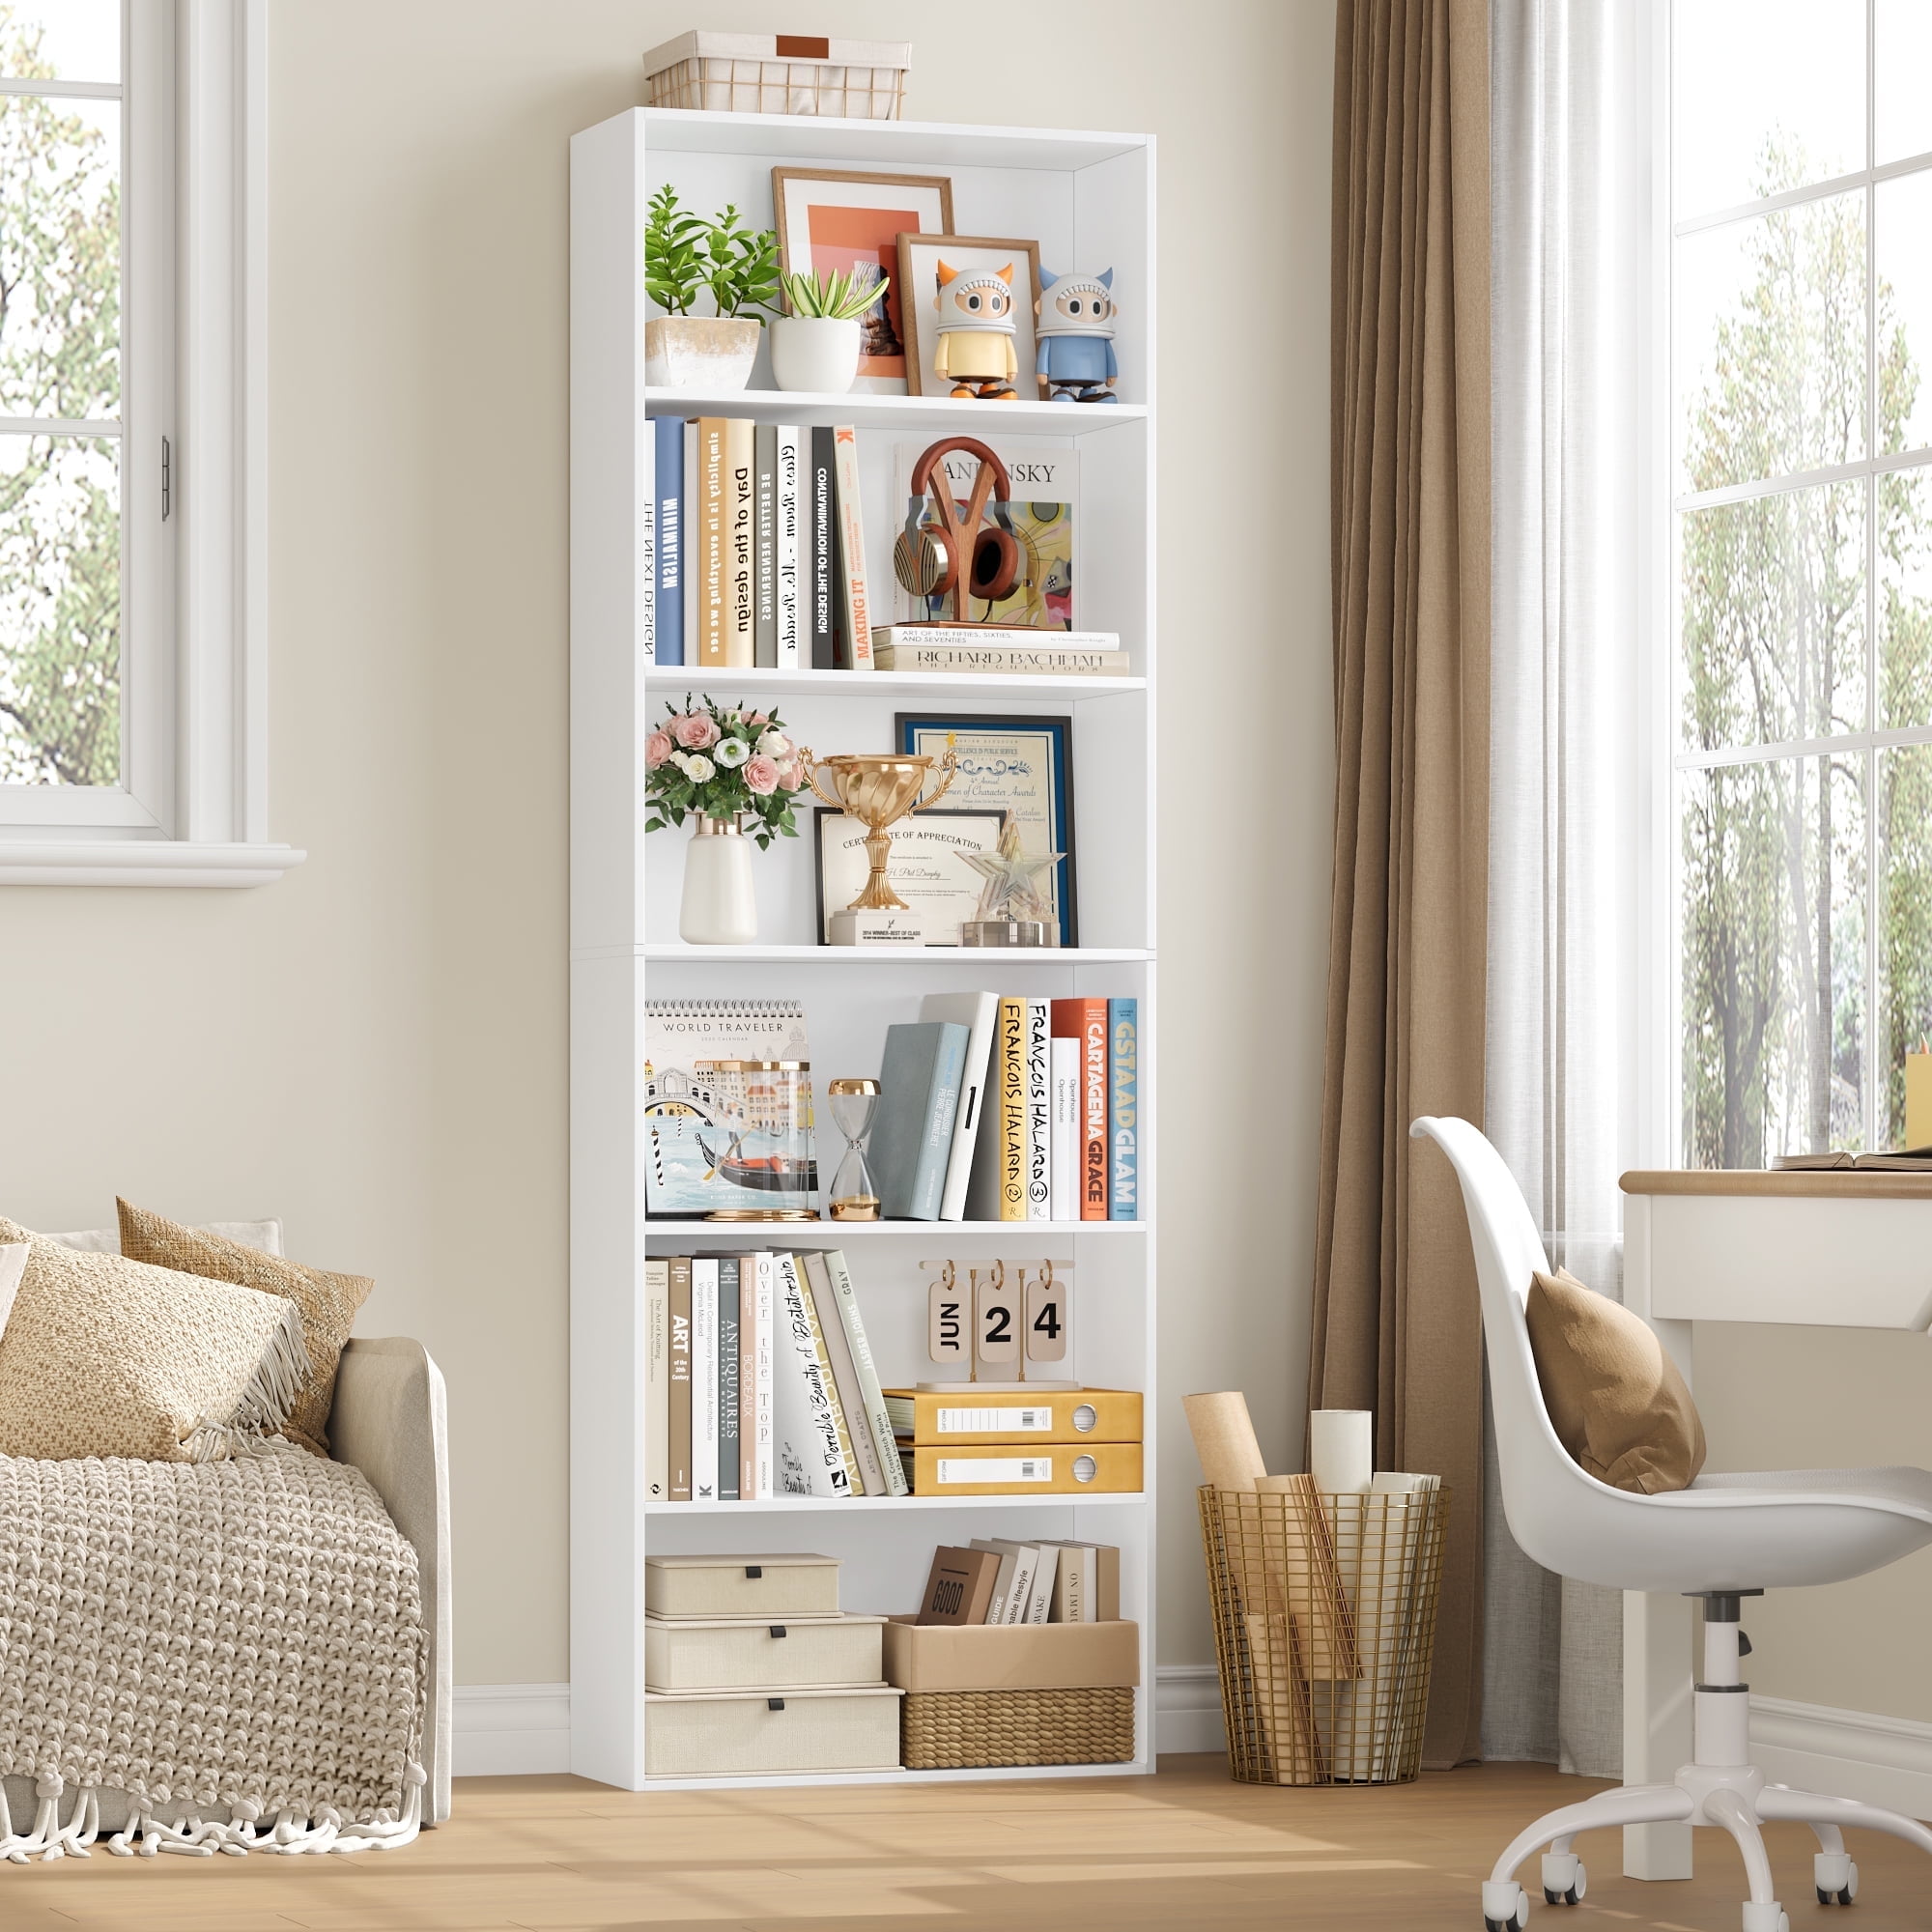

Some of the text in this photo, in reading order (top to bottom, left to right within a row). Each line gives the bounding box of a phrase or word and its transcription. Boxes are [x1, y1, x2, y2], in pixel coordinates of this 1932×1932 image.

[851, 579, 864, 594] IT
[853, 598, 869, 659] MAKING
[918, 650, 1102, 667] RICHARD BACHMAN
[917, 831, 982, 851] APPRECIATION
[663, 1022, 784, 1033] WORLD TRAVELER
[1005, 1005, 1021, 1099] FRANÇOIS
[1027, 1005, 1046, 1099] FRANÇOIS
[1087, 1022, 1104, 1141] CARTAGENA
[1115, 1021, 1136, 1128] GSTAAD
[936, 1088, 947, 1110] PIERRE
[1005, 1104, 1023, 1180] HALARD
[1032, 1104, 1047, 1180] HALARD
[1088, 1141, 1104, 1203] GRACE
[1115, 1128, 1137, 1203] GLAM
[838, 1270, 852, 1295] GRAY
[672, 1315, 688, 1353] ART
[705, 1311, 714, 1358] Contemporary
[847, 1303, 873, 1370] JASPER JOHNS
[940, 1303, 959, 1350] JUN
[985, 1306, 1011, 1343] 2
[1034, 1302, 1061, 1339] 4
[796, 1347, 814, 1359] of
[724, 1320, 738, 1438] ANTIQUAIRES
[743, 1354, 753, 1417] BORDEAUX
[803, 1362, 827, 1411] Beauty
[816, 1412, 841, 1465] Terrible
[876, 1413, 886, 1436] Works
[881, 1436, 895, 1473] Crosshatch
[932, 1579, 964, 1616] GOOD
[1012, 1570, 1028, 1602] lifestyle
[1069, 1573, 1079, 1588] ON
[990, 1595, 1004, 1625] GUIDE
